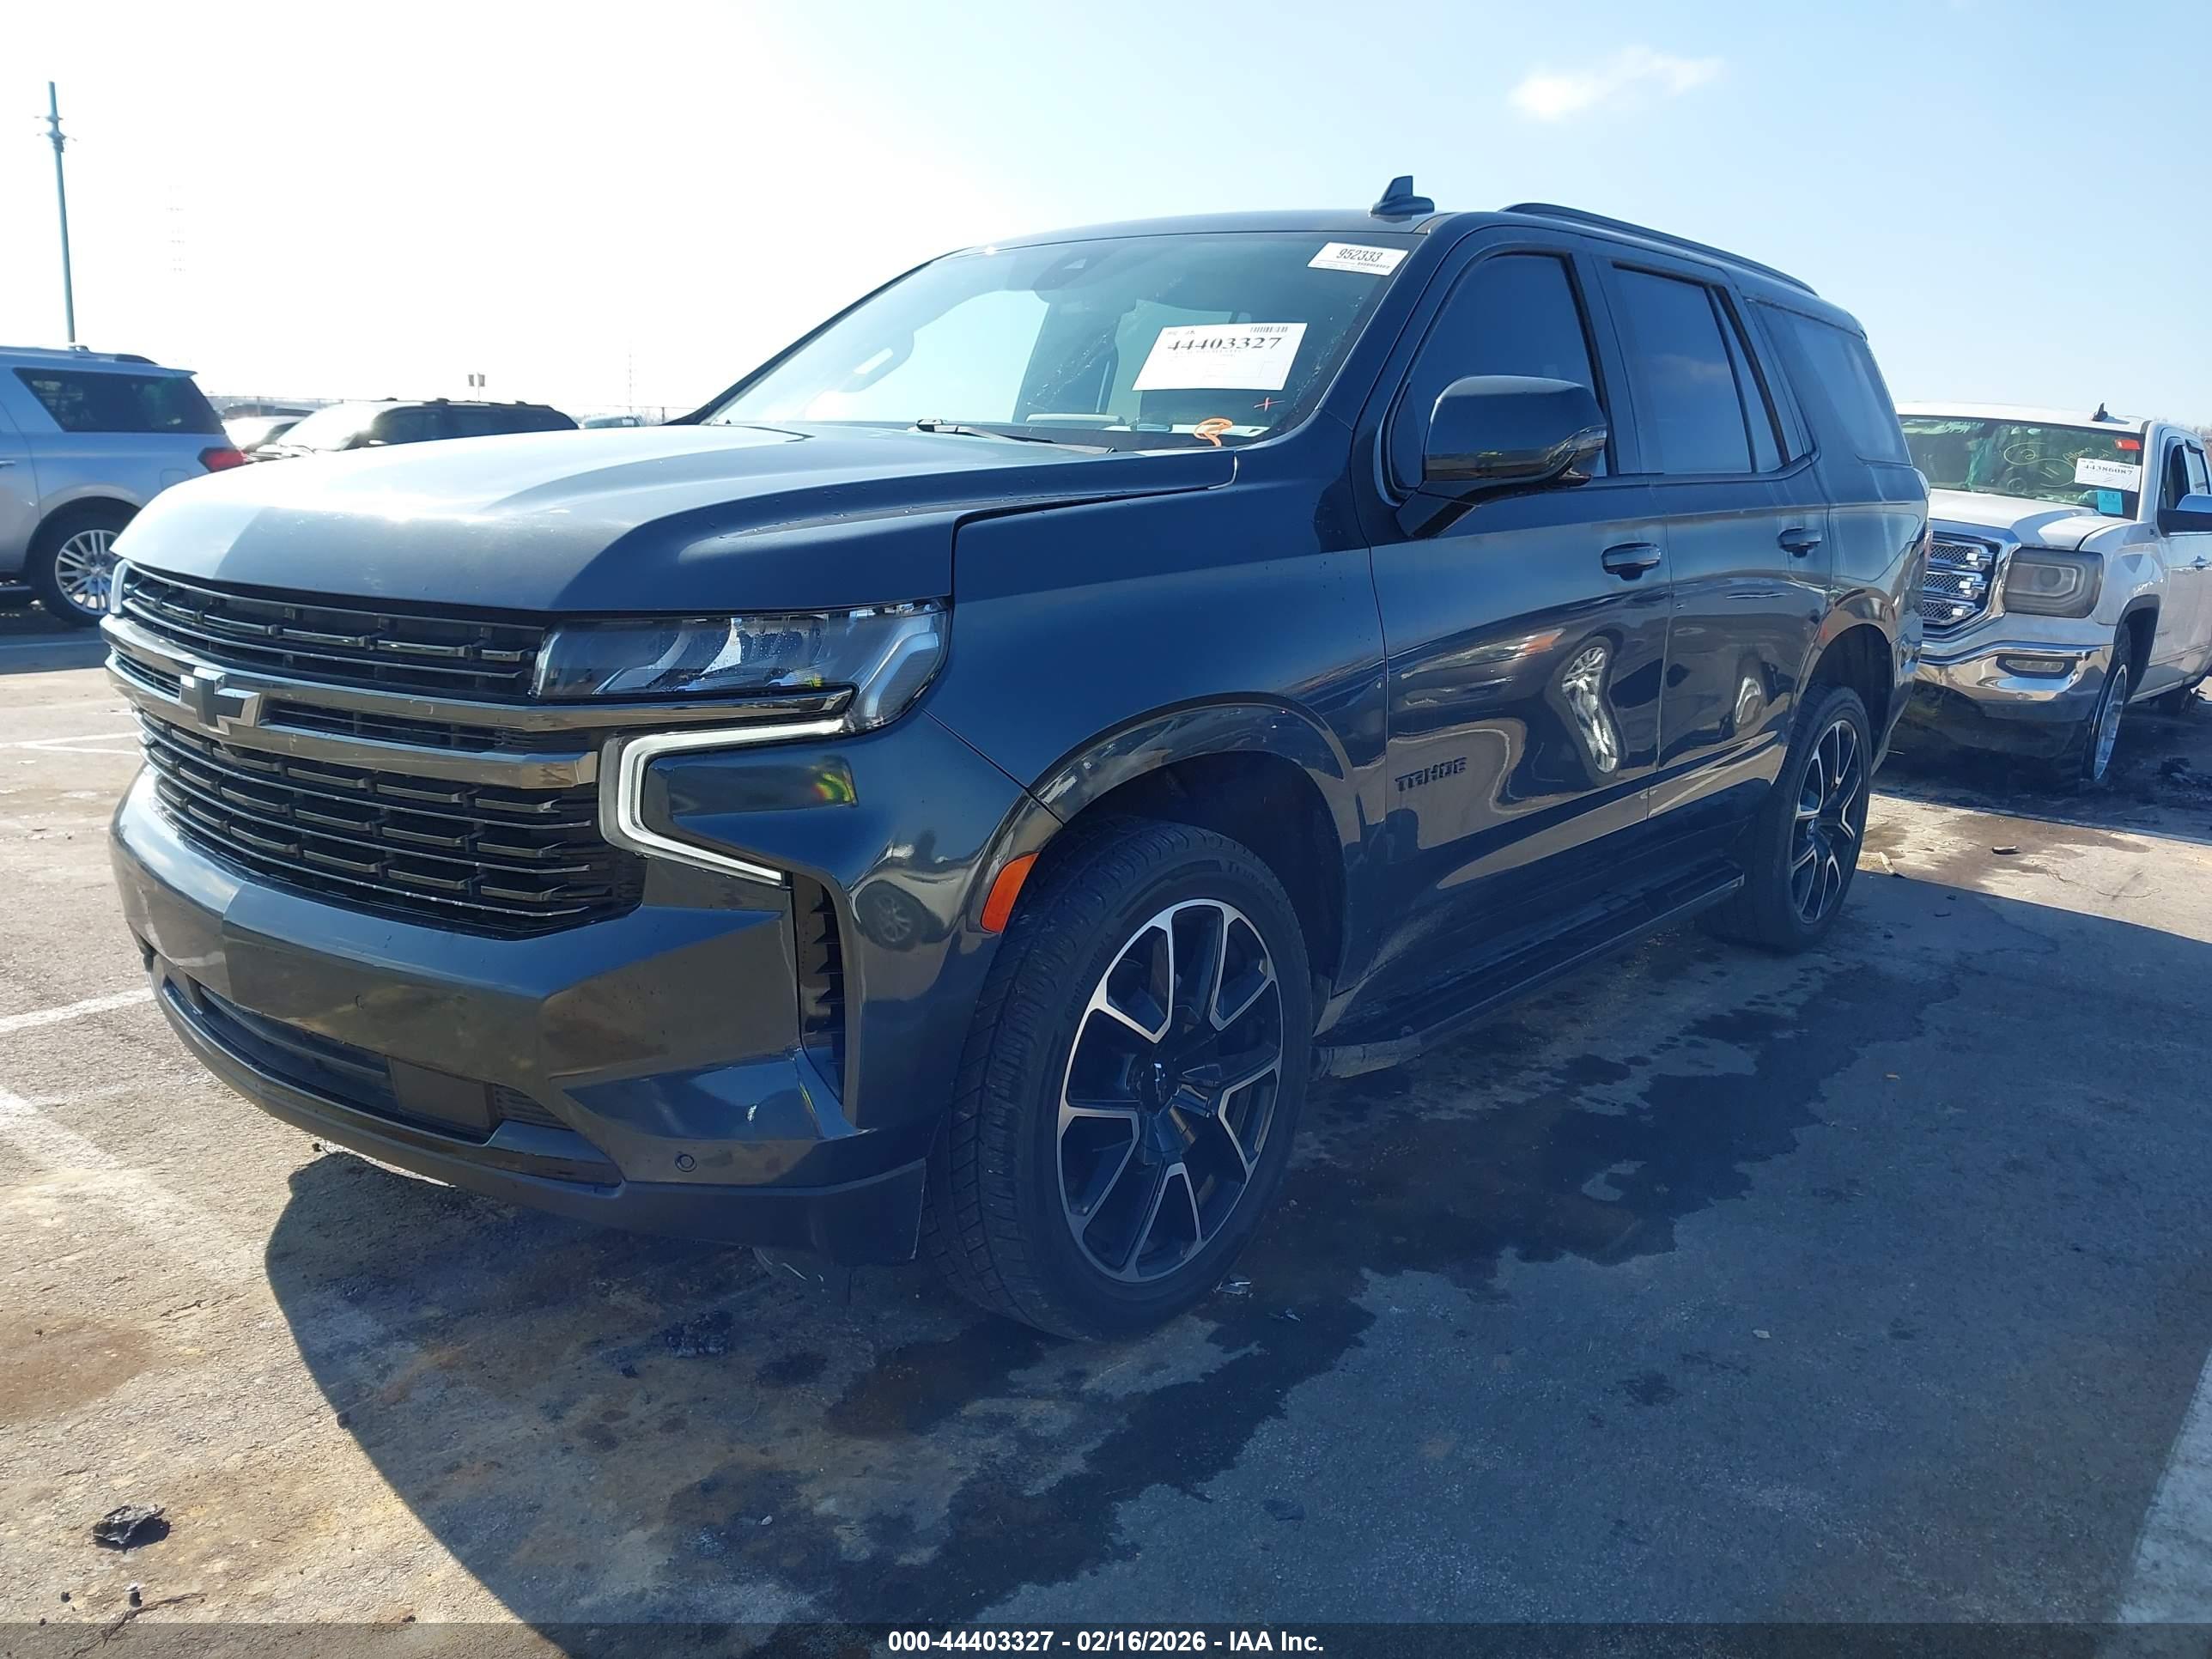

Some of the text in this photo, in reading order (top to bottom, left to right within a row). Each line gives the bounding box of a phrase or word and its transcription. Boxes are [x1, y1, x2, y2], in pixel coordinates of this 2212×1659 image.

[1336, 248, 1383, 263] 952333
[1167, 337, 1283, 351] 44403327
[1395, 757, 1468, 792] TAHOE
